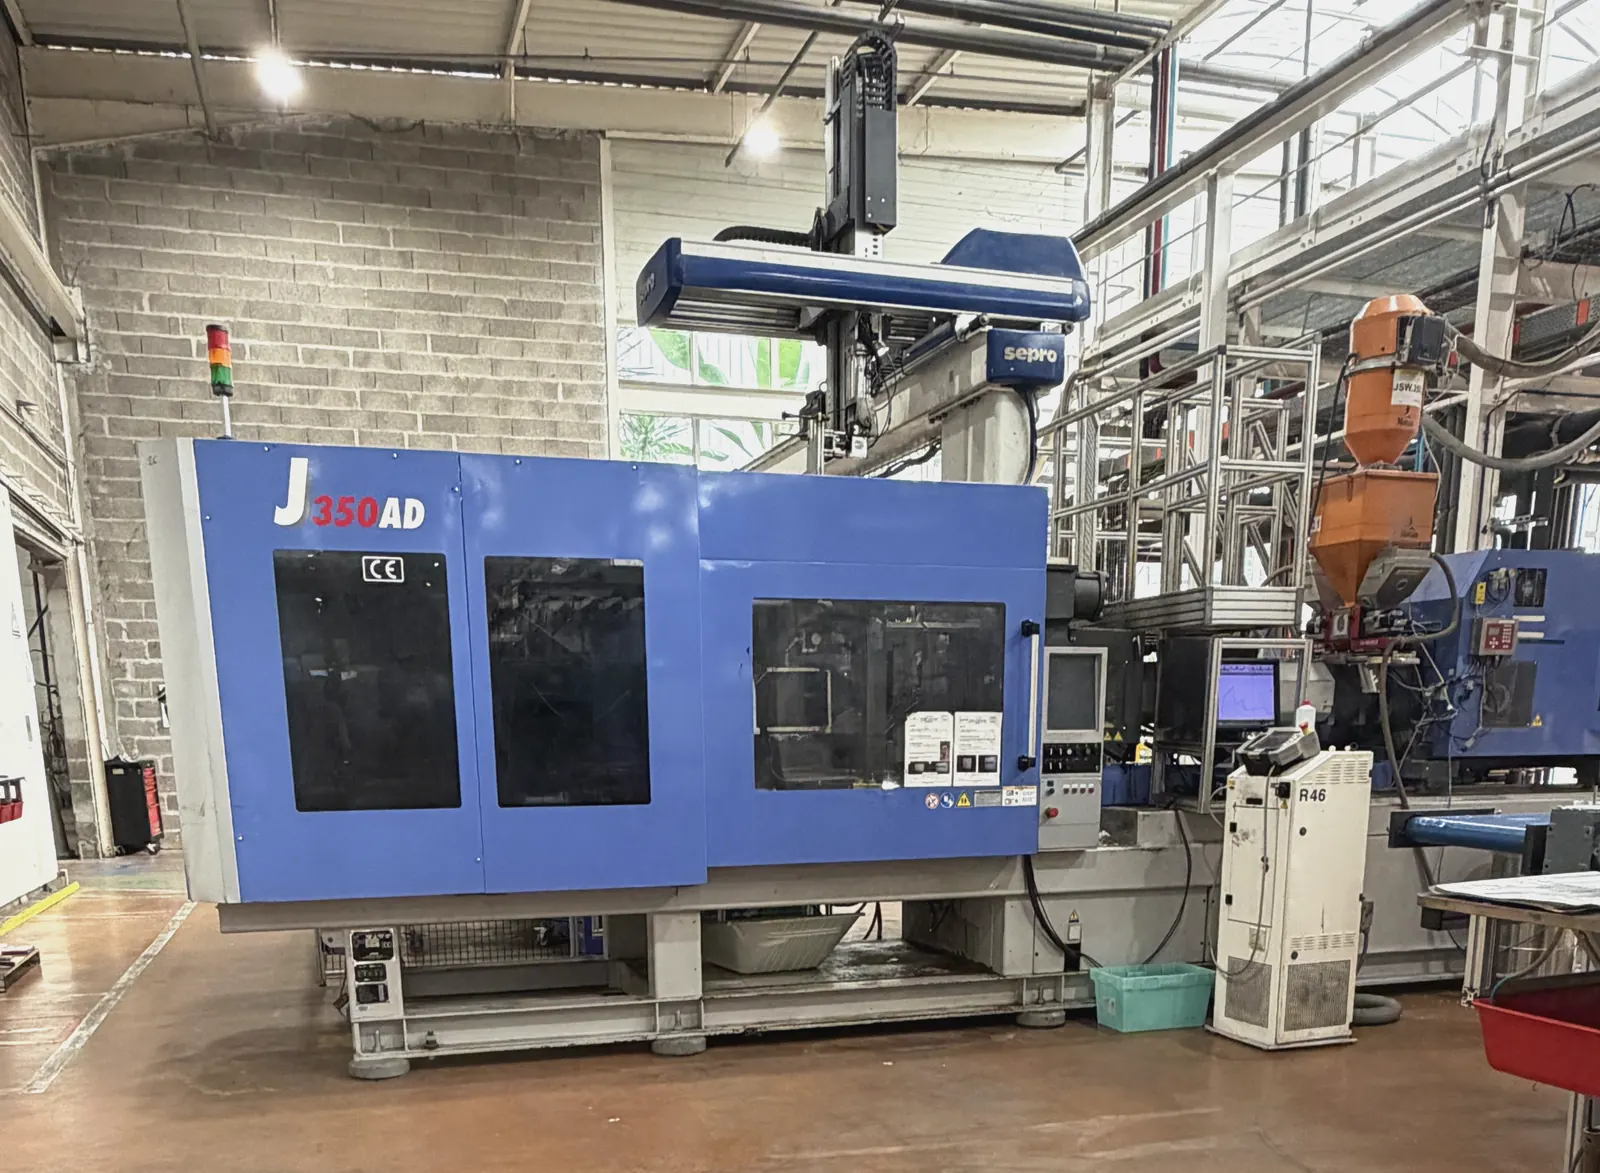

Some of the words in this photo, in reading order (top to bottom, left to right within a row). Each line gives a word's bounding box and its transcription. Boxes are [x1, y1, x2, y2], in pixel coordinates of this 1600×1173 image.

[1004, 346, 1058, 364] sepro
[273, 457, 425, 529] J350AD
[369, 559, 397, 579] CE
[1299, 788, 1327, 802] R46
